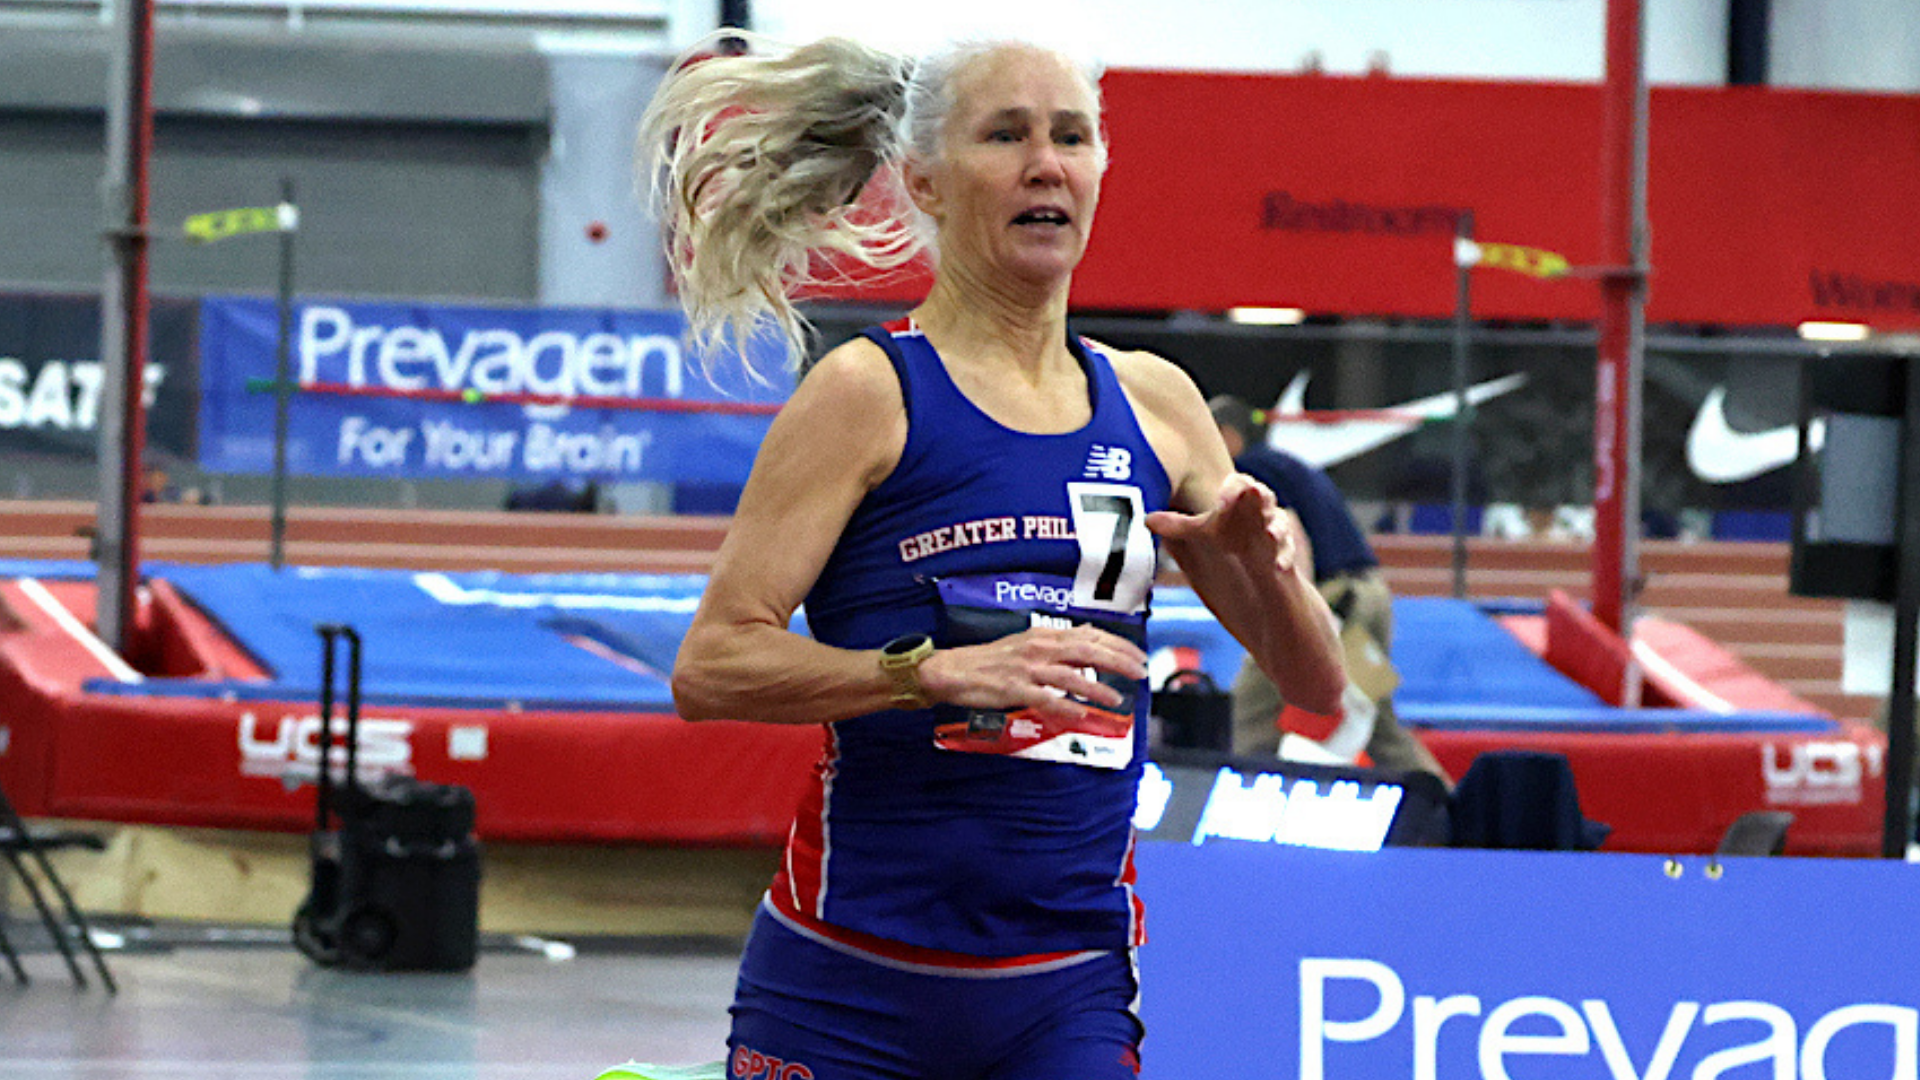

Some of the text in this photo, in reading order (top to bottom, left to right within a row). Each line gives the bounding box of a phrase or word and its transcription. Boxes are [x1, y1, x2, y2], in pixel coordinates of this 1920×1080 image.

[1261, 190, 1473, 237] Restroom
[300, 306, 683, 419] Prevagen
[0, 358, 165, 429] SAT
[338, 416, 413, 468] For
[421, 419, 517, 469] Your
[523, 422, 643, 472] Brain
[899, 517, 1017, 563] GREATER
[1080, 494, 1133, 602] 7
[240, 712, 413, 764] UCS
[733, 1044, 814, 1080] GPTC
